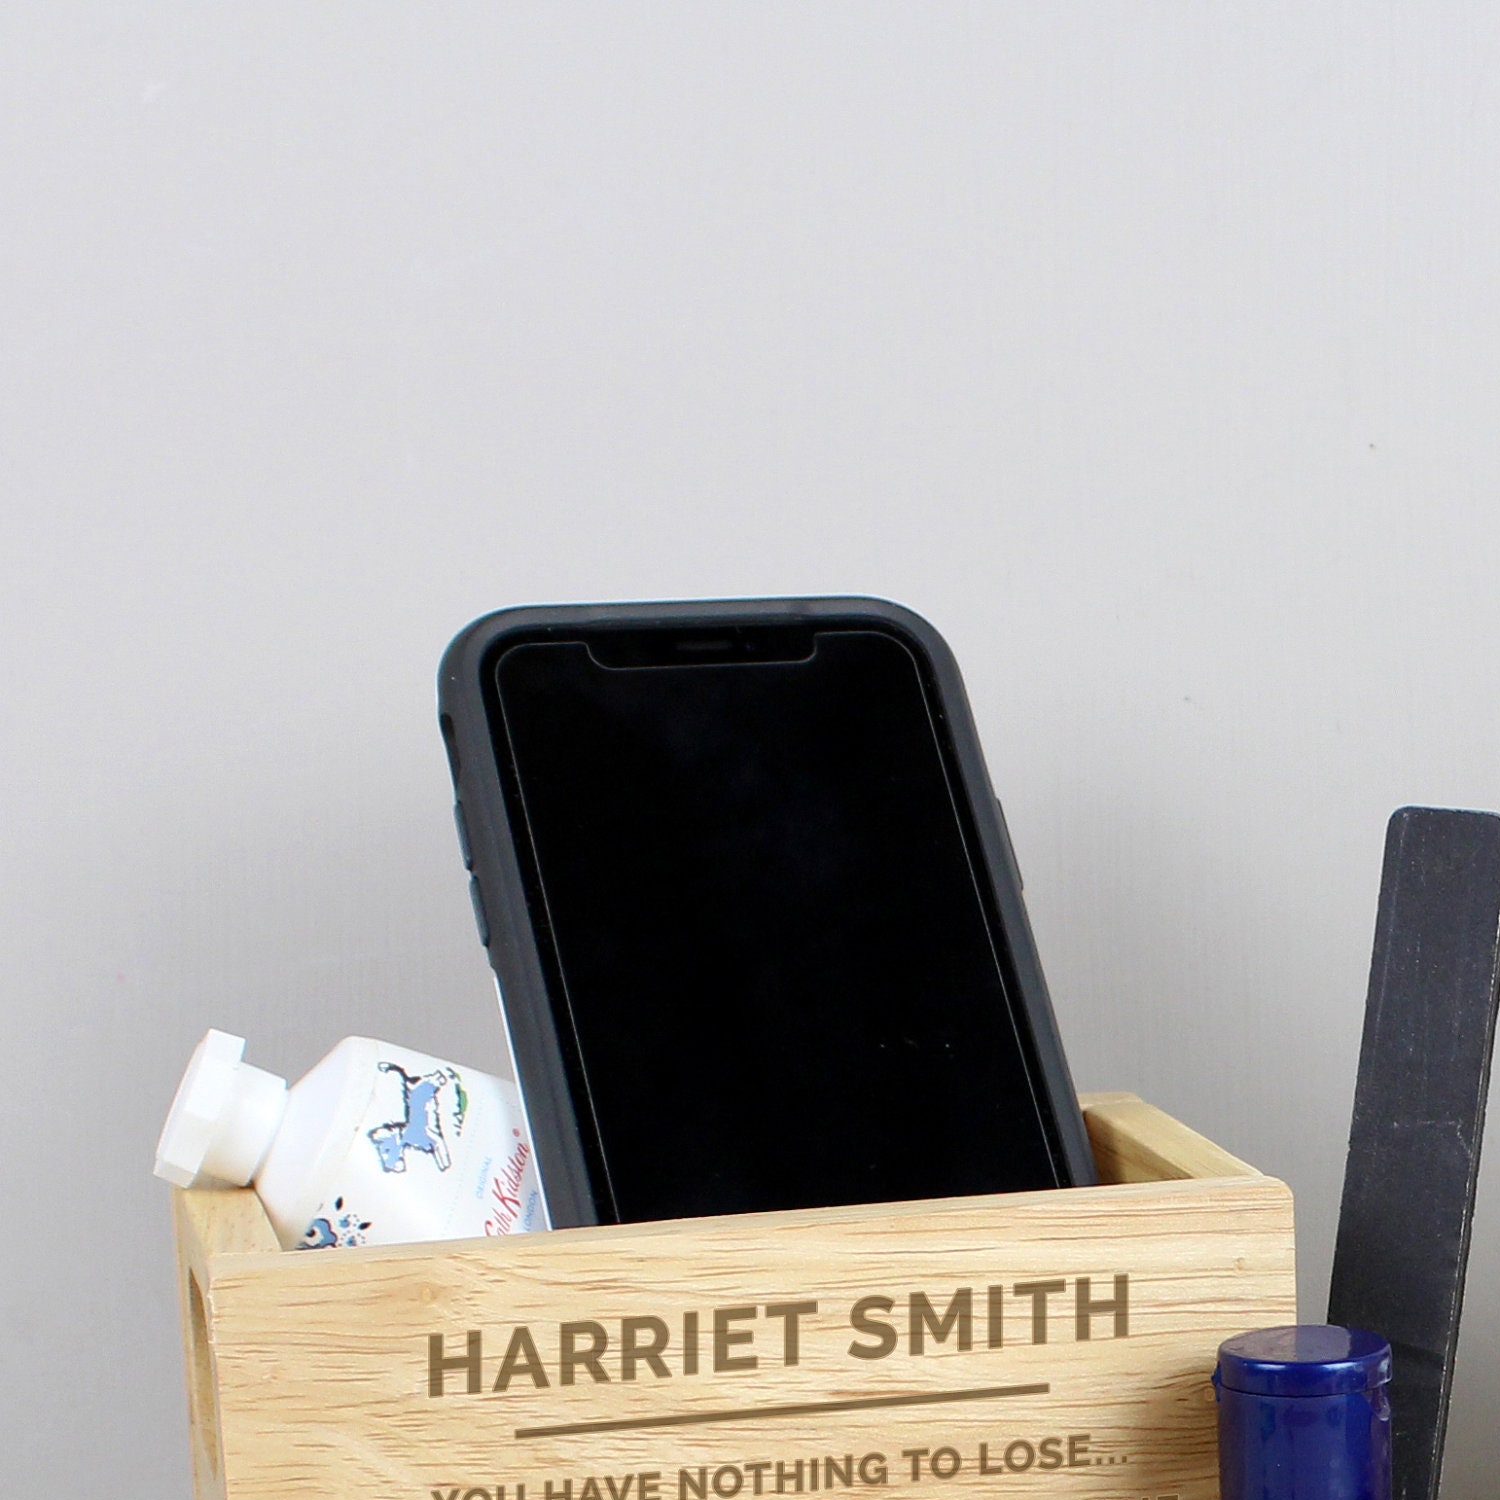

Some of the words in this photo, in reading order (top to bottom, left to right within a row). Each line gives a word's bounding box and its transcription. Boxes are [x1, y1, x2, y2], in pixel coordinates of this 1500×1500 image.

[428, 1300, 818, 1398] HARRIET
[847, 1273, 1131, 1360] SMITH
[901, 1446, 964, 1483] TO
[978, 1433, 1129, 1477] LOSE...
